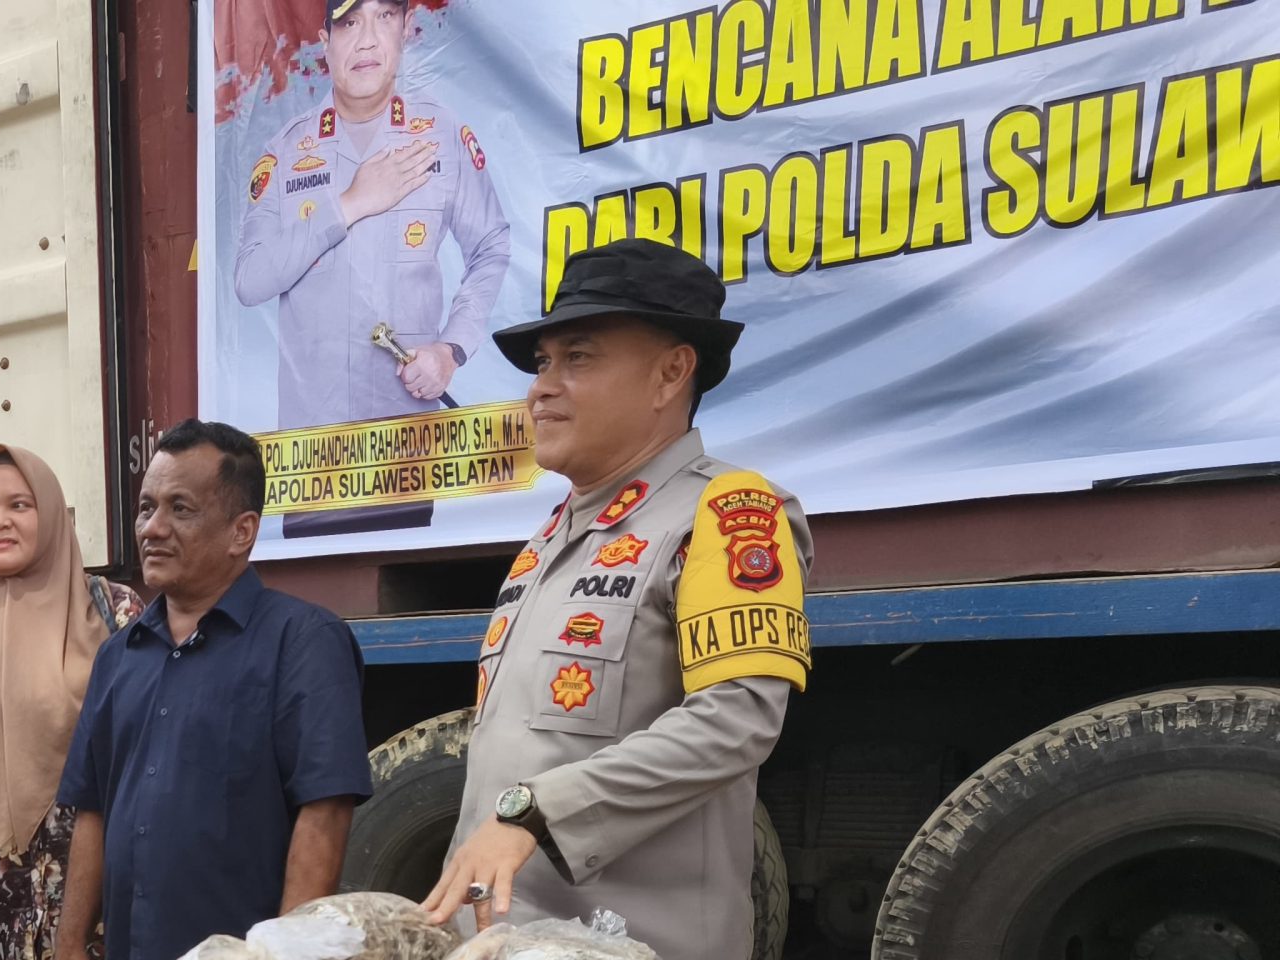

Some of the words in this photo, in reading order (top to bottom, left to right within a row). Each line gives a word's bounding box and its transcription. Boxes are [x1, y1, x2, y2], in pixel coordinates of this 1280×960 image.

[578, 0, 926, 152] BENCANA
[285, 172, 331, 194] DJUHANDANI
[718, 119, 971, 285] POLDA
[981, 54, 1280, 239] SULAW
[265, 442, 289, 473] POL.
[292, 432, 367, 470] DJUHANDHANI
[370, 424, 432, 461] RAHARDJO
[434, 419, 470, 456] PURO,
[502, 412, 528, 446] M.H.
[264, 475, 334, 505] APOLDA
[339, 465, 426, 498] SULAWESI
[432, 456, 514, 489] SELATAN
[716, 492, 777, 507] POLRES
[723, 502, 743, 512] ACEH
[725, 516, 771, 528] ACEH
[569, 574, 637, 598] POLRI
[688, 616, 720, 660] KA
[730, 608, 779, 647] OPS
